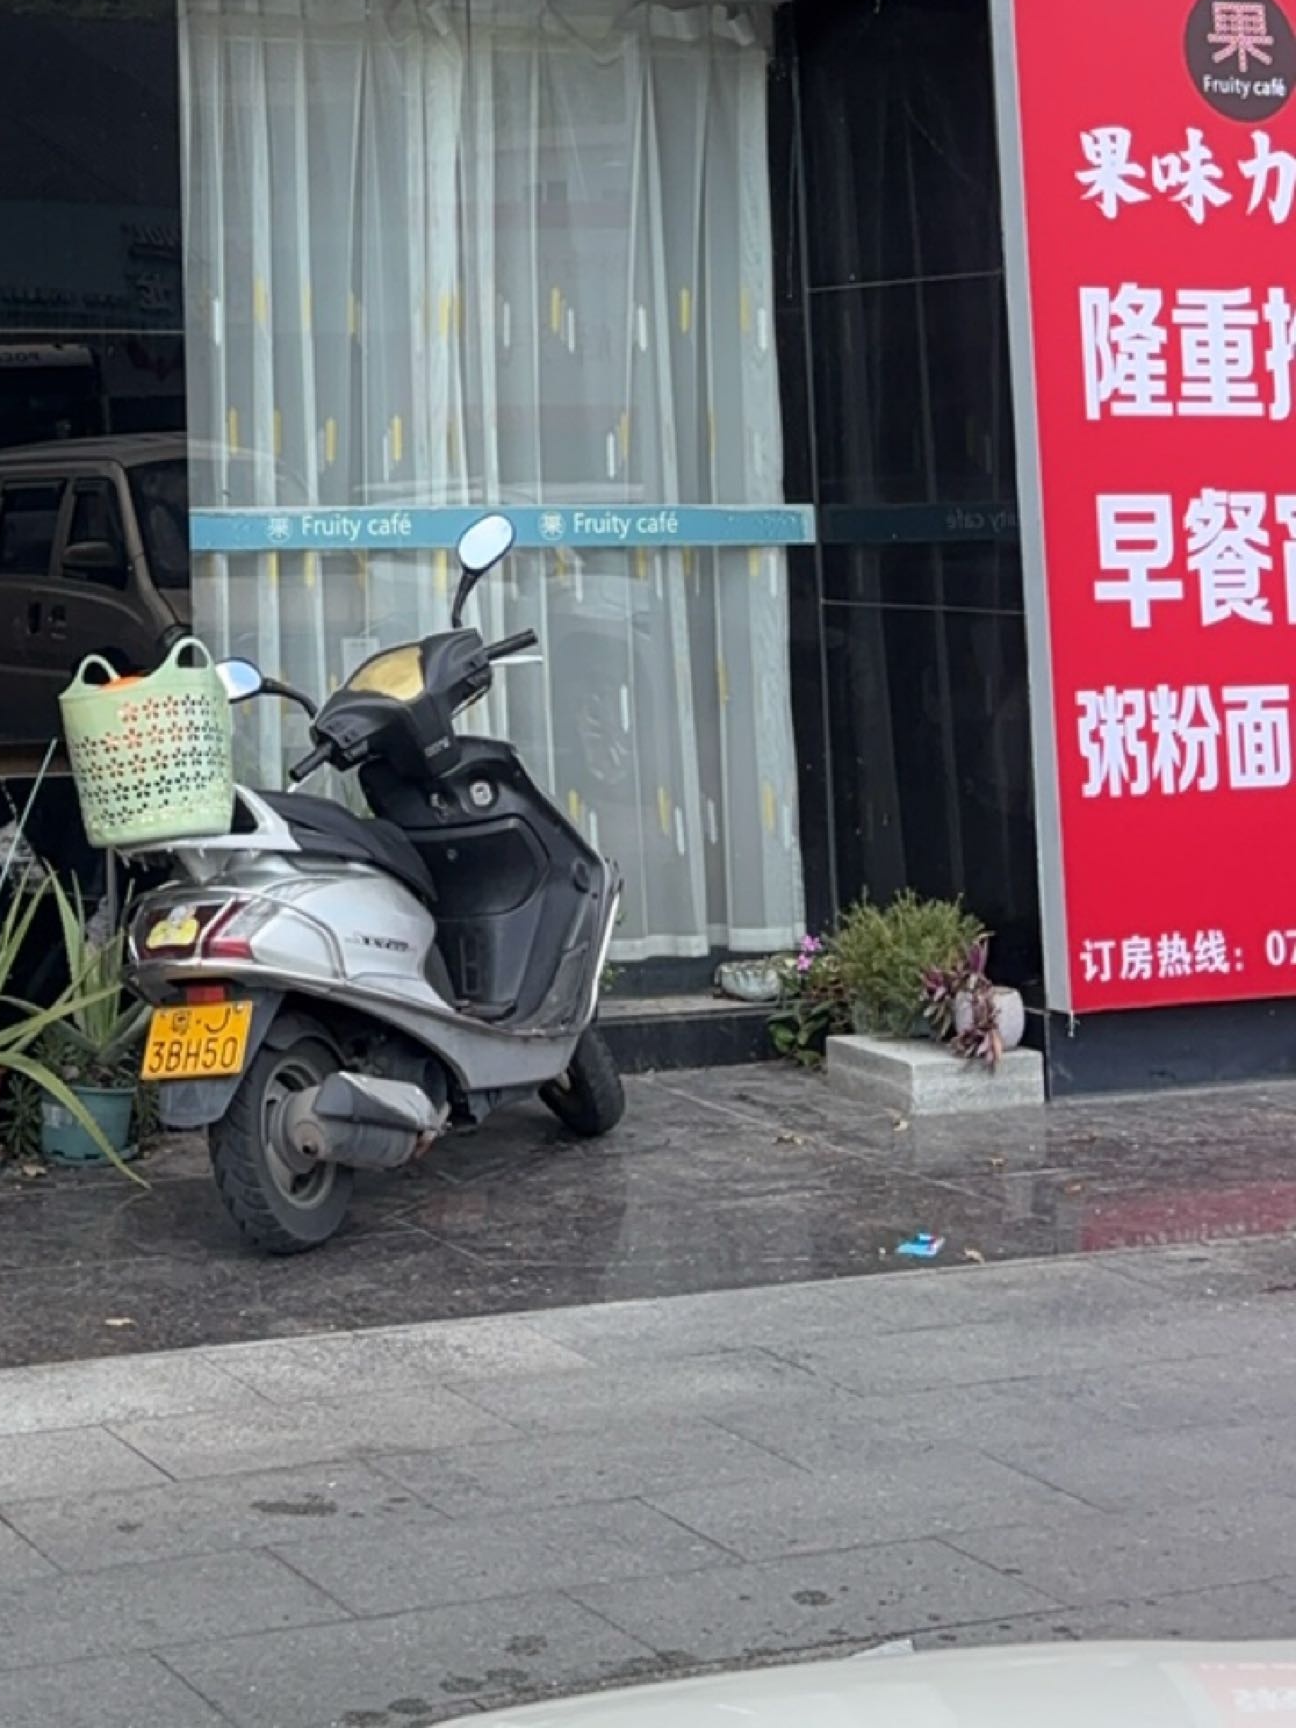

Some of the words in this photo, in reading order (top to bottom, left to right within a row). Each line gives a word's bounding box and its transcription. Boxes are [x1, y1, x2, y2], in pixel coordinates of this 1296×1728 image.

[1206, 0, 1275, 73] 果
[1202, 74, 1251, 100] Fruity
[301, 514, 362, 541] Fruity
[366, 512, 412, 536] café
[573, 511, 632, 540] Fruity
[636, 511, 679, 534] café
[1094, 487, 1296, 629] 早餐
[1074, 683, 1292, 799] 粥粉面
